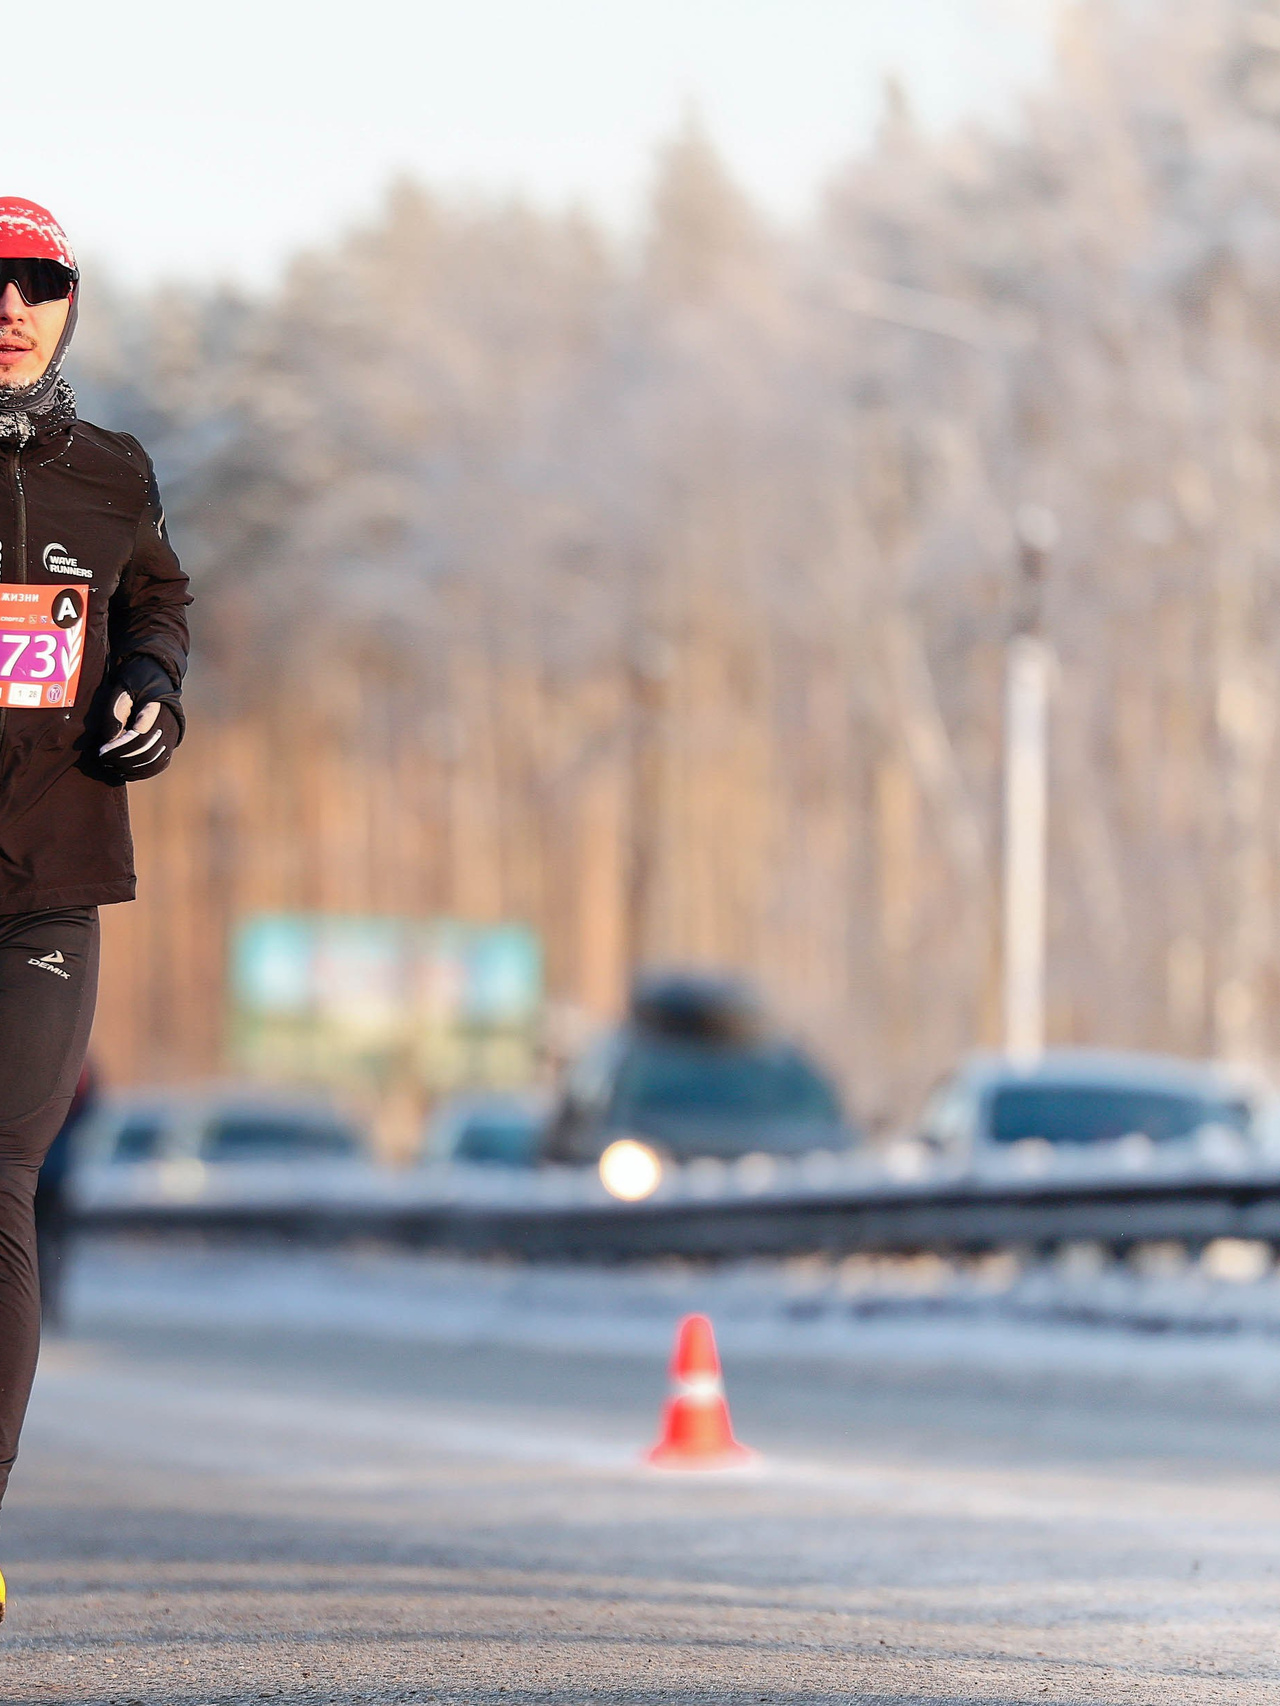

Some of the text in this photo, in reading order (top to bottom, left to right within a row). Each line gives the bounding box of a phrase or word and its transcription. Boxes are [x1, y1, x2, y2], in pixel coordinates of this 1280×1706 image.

[49, 555, 78, 567] WAVE
[49, 564, 93, 578] RUNNERS
[1, 592, 40, 602] ЖИЗНИ
[27, 958, 71, 980] DEMIX
